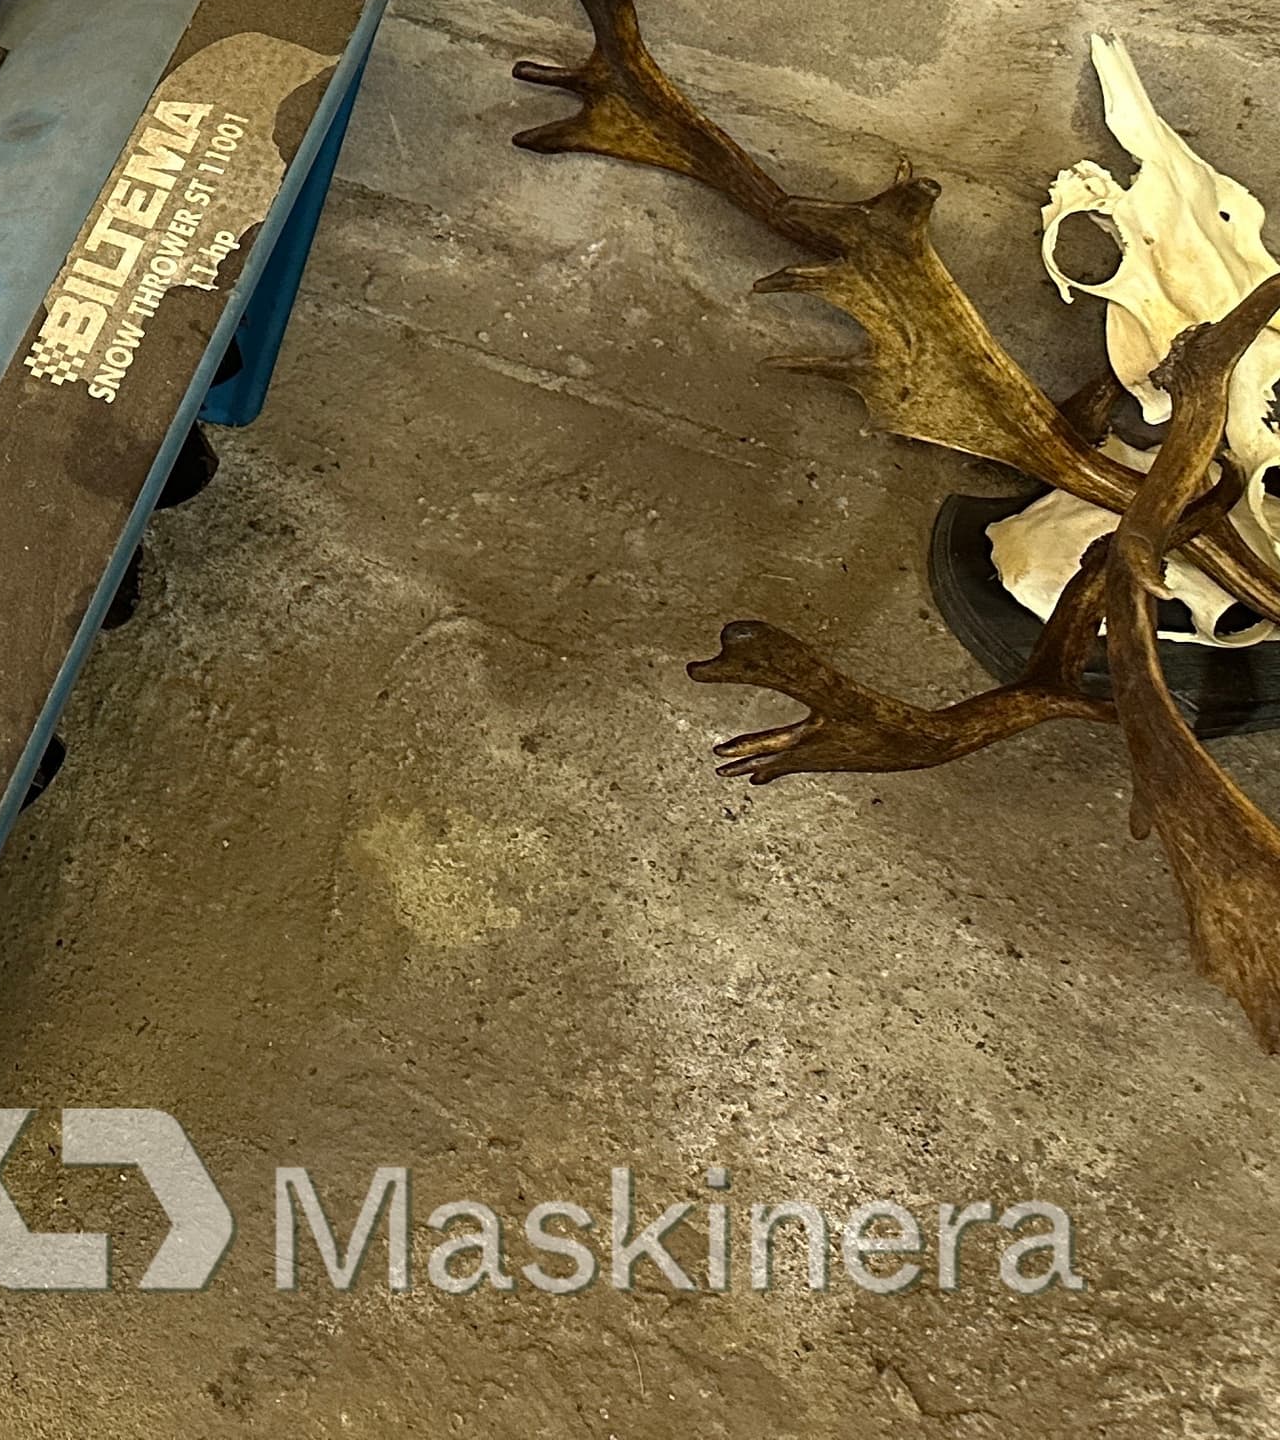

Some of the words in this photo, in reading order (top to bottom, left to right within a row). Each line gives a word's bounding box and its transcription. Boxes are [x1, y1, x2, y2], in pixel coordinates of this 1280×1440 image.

[197, 113, 250, 176] 11001
[38, 100, 214, 354] BILTEMA
[184, 177, 217, 208] ST
[127, 208, 203, 318] THROWER
[87, 320, 146, 404] SNOW
